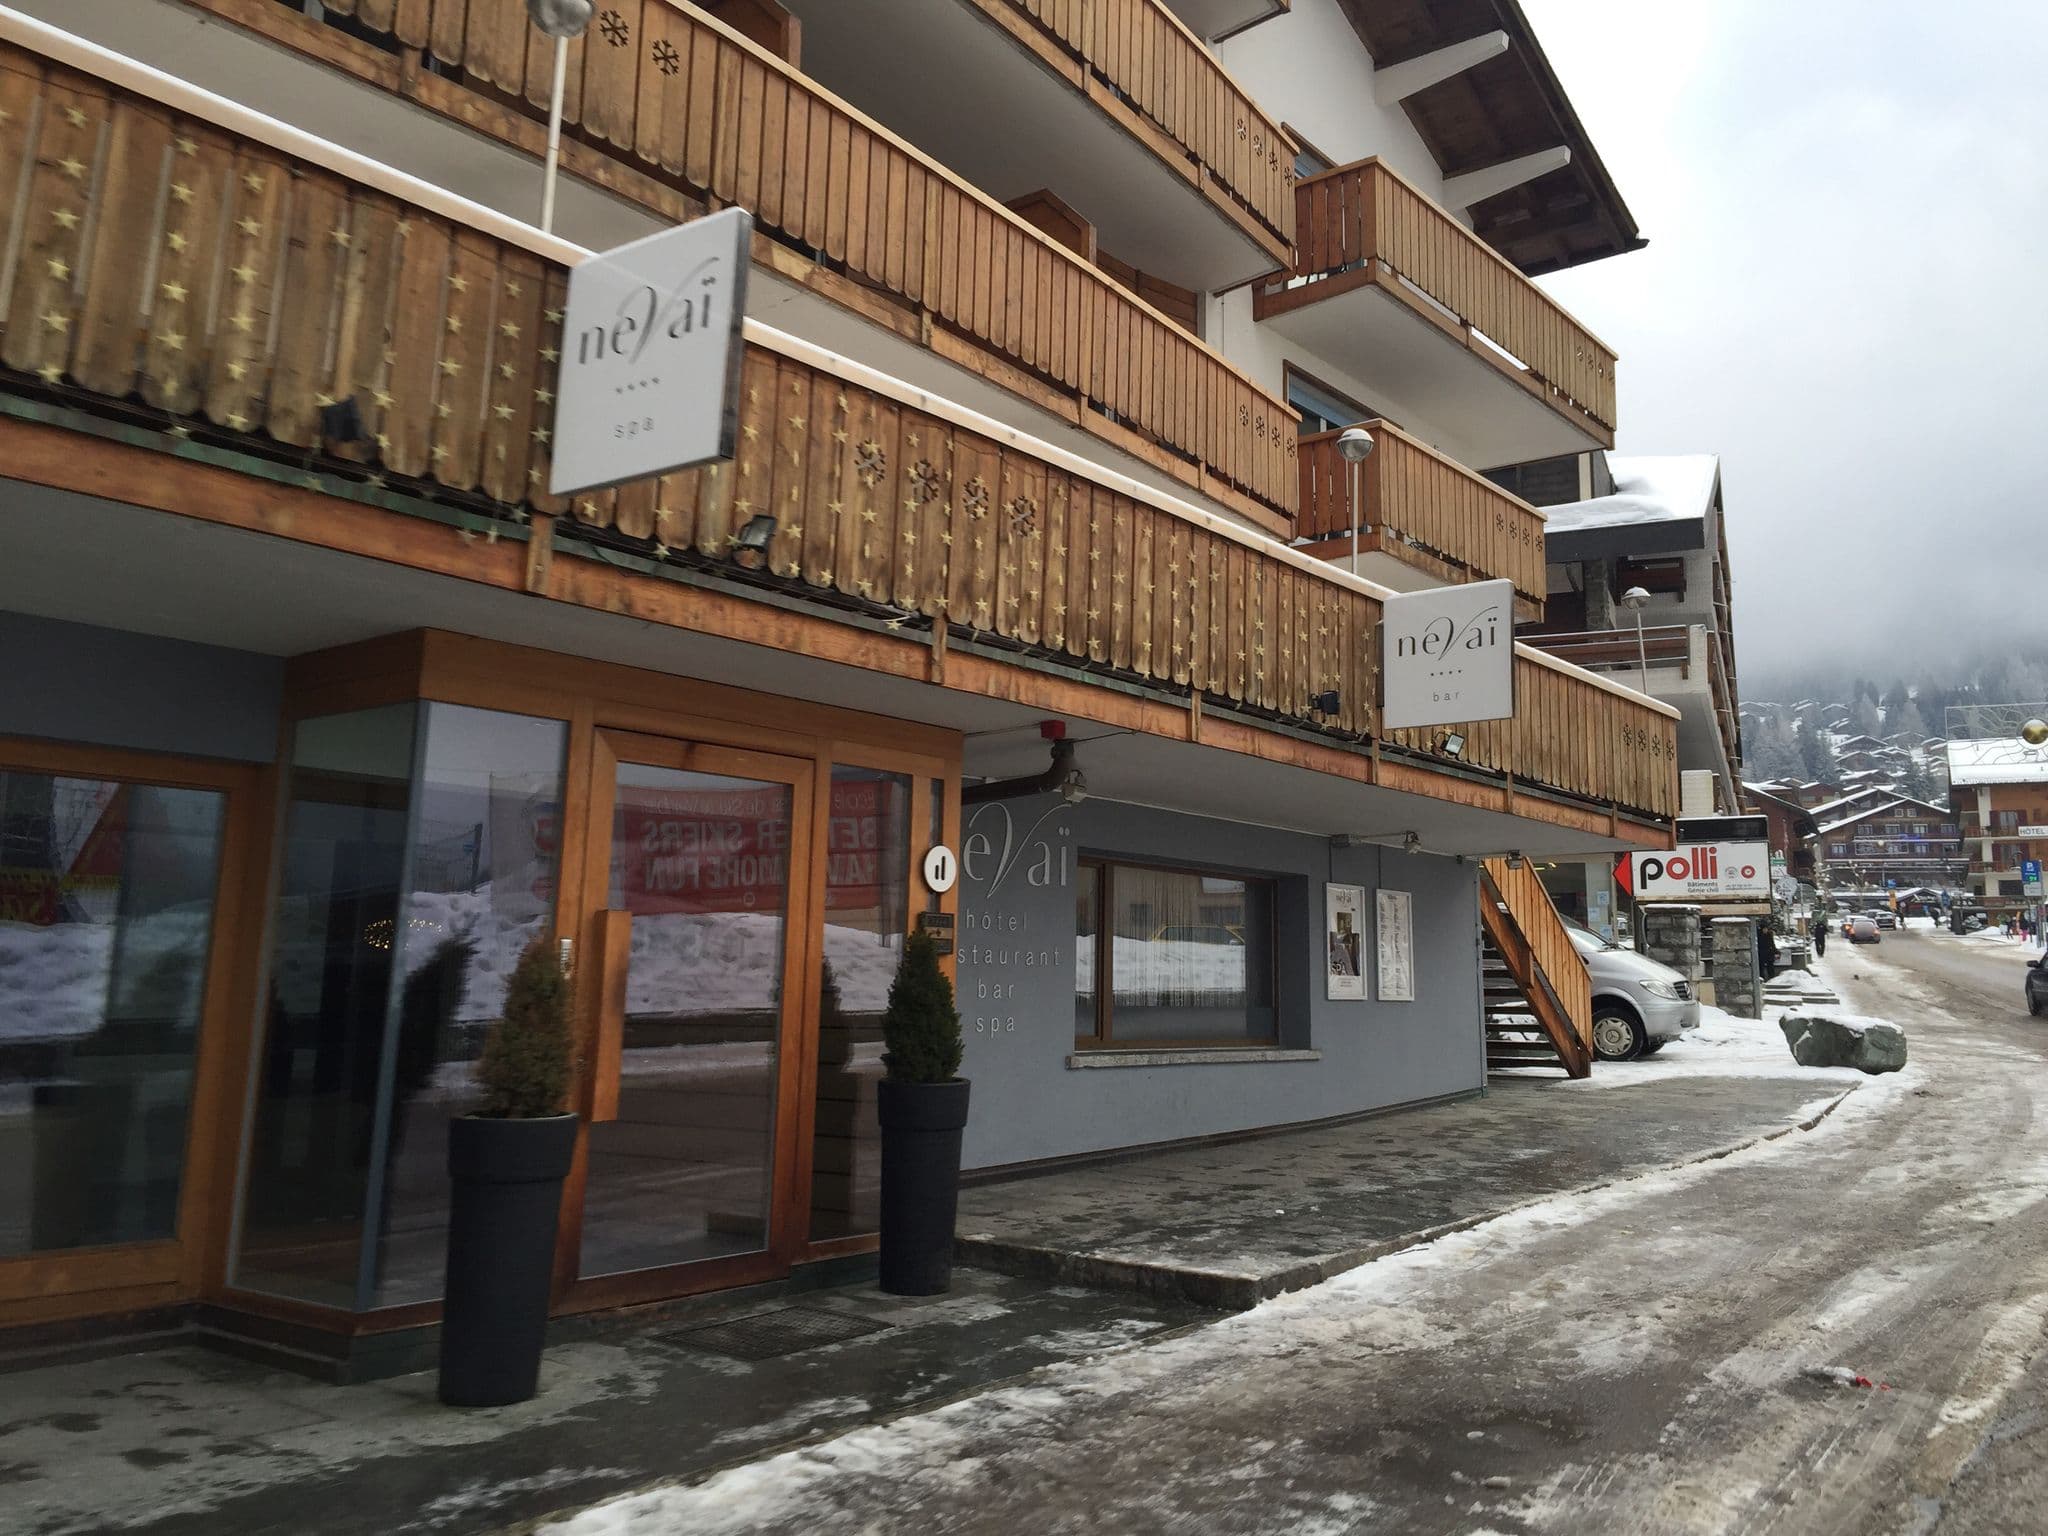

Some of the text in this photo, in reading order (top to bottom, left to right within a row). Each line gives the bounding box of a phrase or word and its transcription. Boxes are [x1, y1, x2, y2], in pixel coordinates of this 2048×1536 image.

[613, 417, 655, 439] spa
[1432, 692, 1460, 702] bar
[963, 802, 1072, 899] evaï
[1640, 846, 1718, 890] polli
[957, 943, 1062, 966] staurant
[978, 977, 1015, 999] bar
[976, 1017, 1015, 1039] spa
